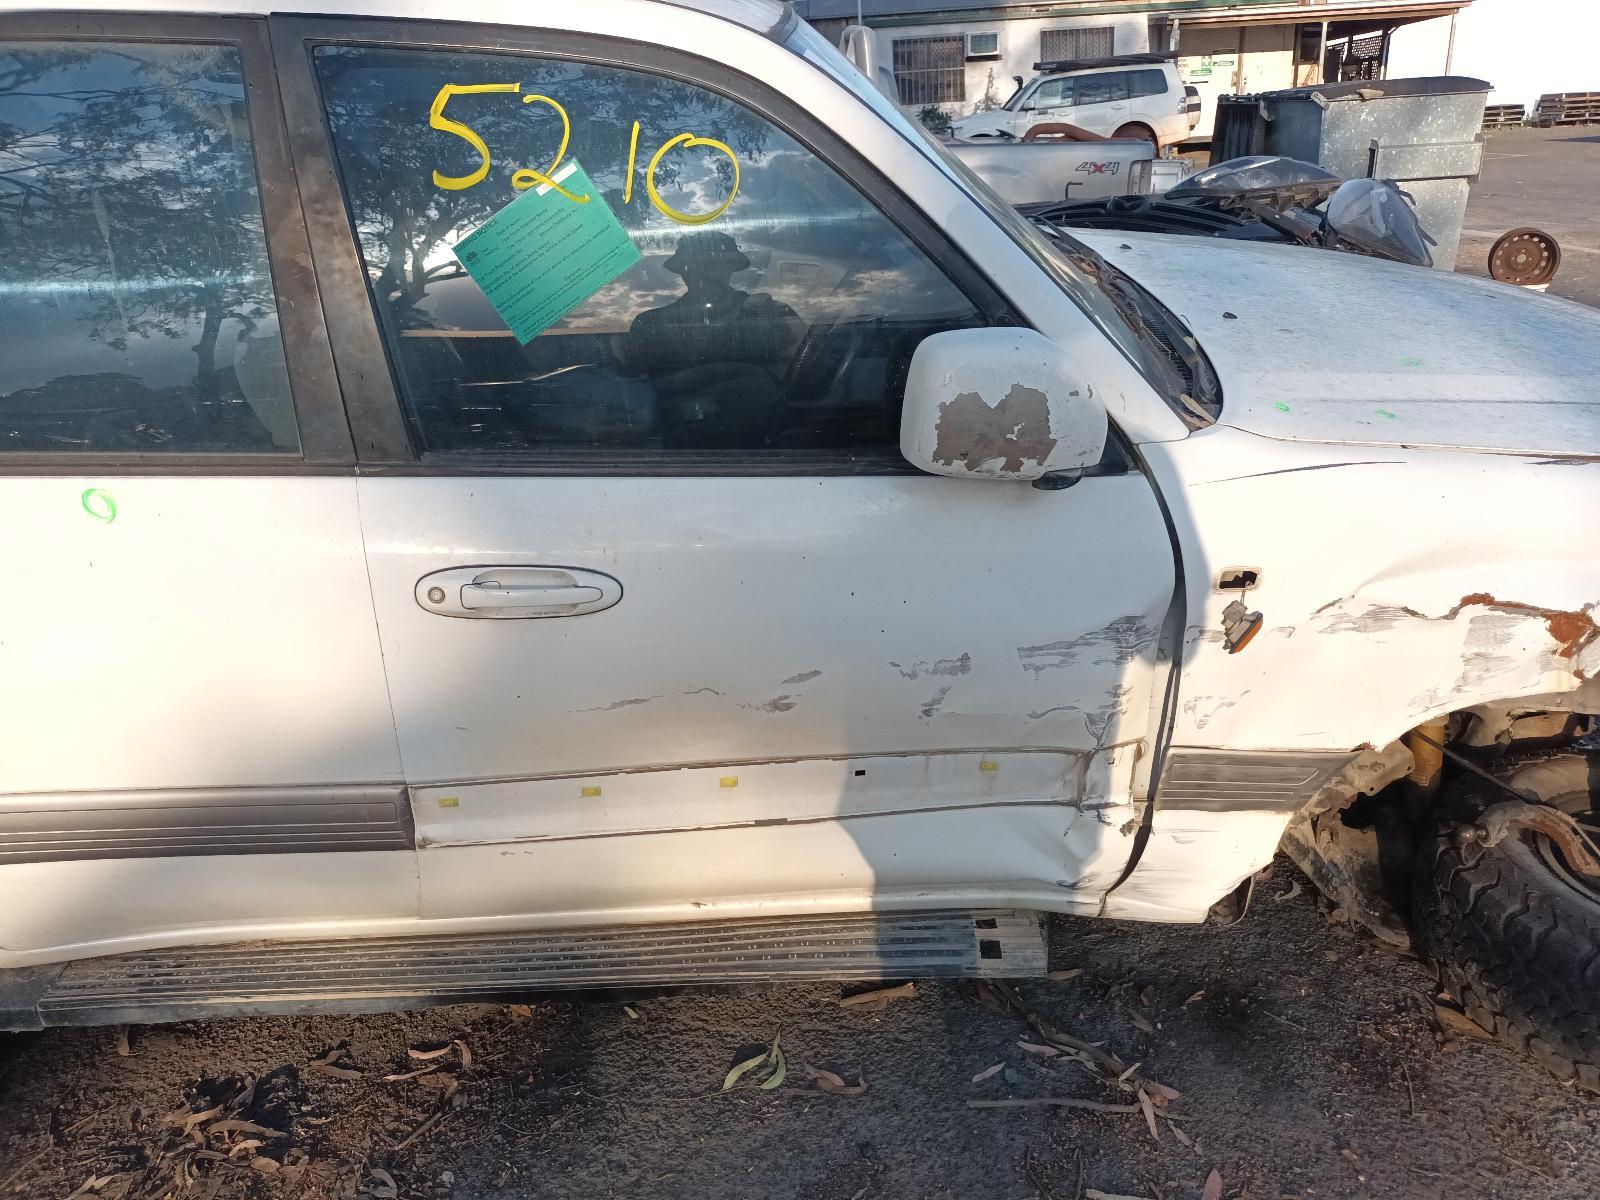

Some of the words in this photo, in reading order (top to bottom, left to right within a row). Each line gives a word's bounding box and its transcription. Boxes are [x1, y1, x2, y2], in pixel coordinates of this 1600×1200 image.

[430, 82, 740, 225] 5210
[452, 232, 478, 254] TOWING
[475, 217, 499, 237] NOTICE
